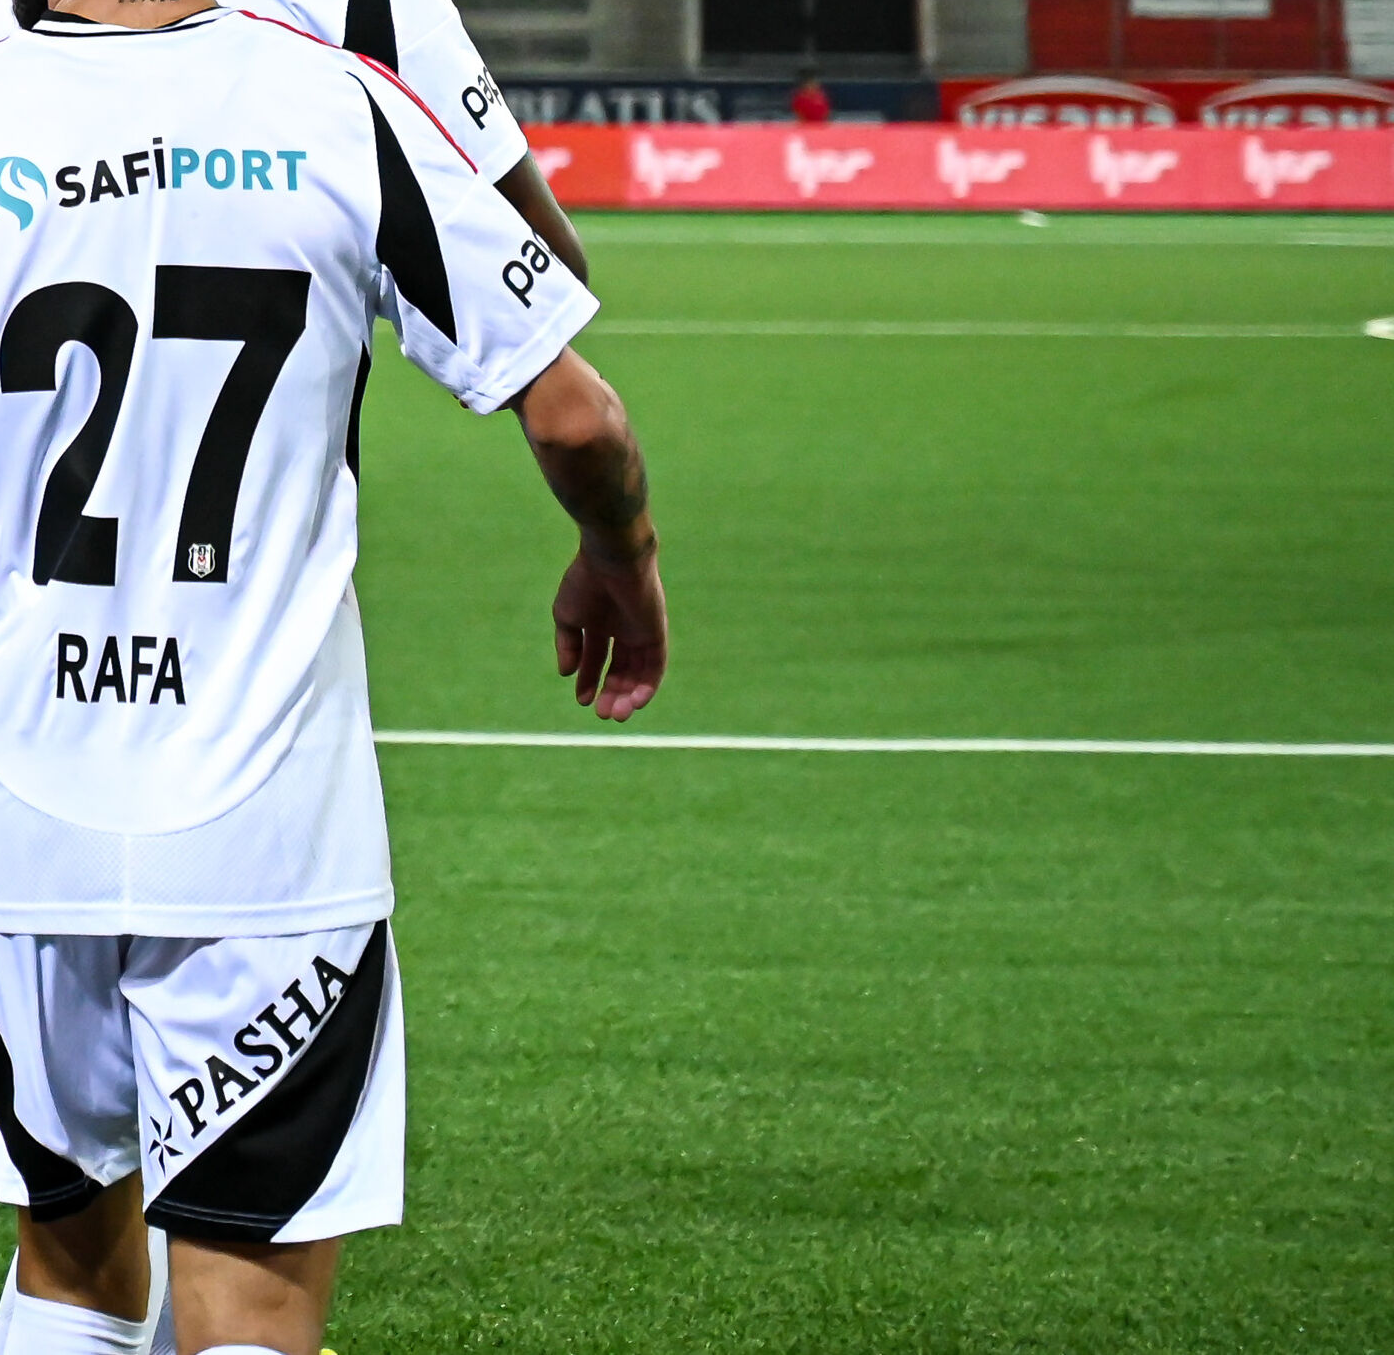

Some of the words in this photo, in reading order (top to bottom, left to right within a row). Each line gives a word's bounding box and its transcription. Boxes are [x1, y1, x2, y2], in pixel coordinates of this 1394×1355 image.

[502, 230, 563, 310] pa
[0, 264, 312, 588] 27
[56, 632, 187, 706] RAFA
[170, 955, 355, 1139] PASHA
